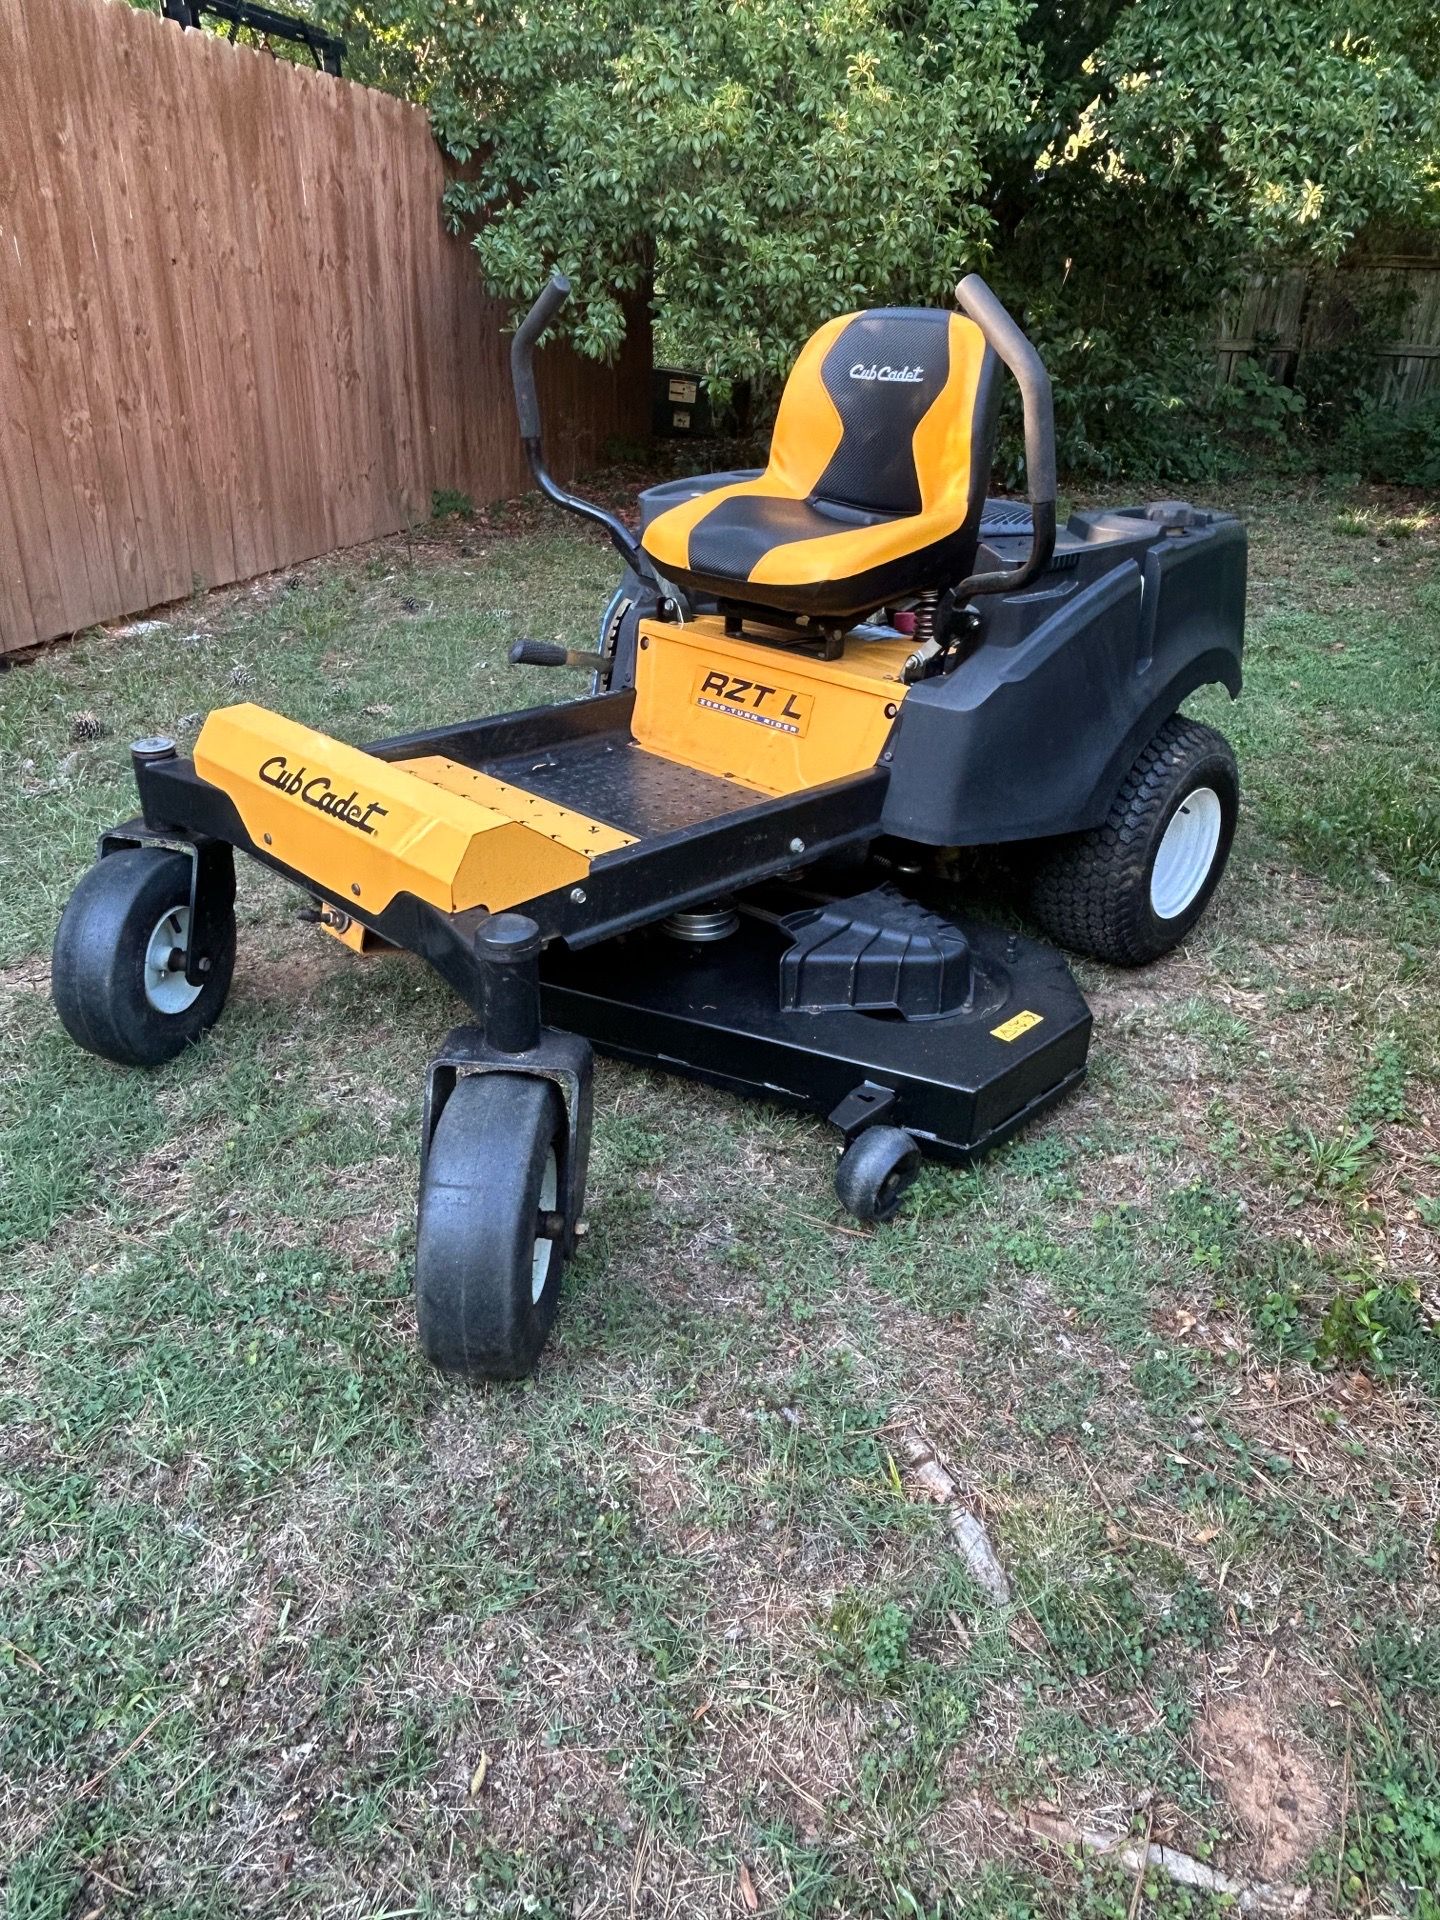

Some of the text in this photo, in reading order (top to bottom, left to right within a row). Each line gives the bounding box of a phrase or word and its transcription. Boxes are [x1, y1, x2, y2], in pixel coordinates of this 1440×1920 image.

[849, 363, 924, 382] Cub Cadet
[700, 671, 802, 720] RZT L
[763, 717, 798, 733] RIDER
[258, 756, 389, 836] Cub Cadet
